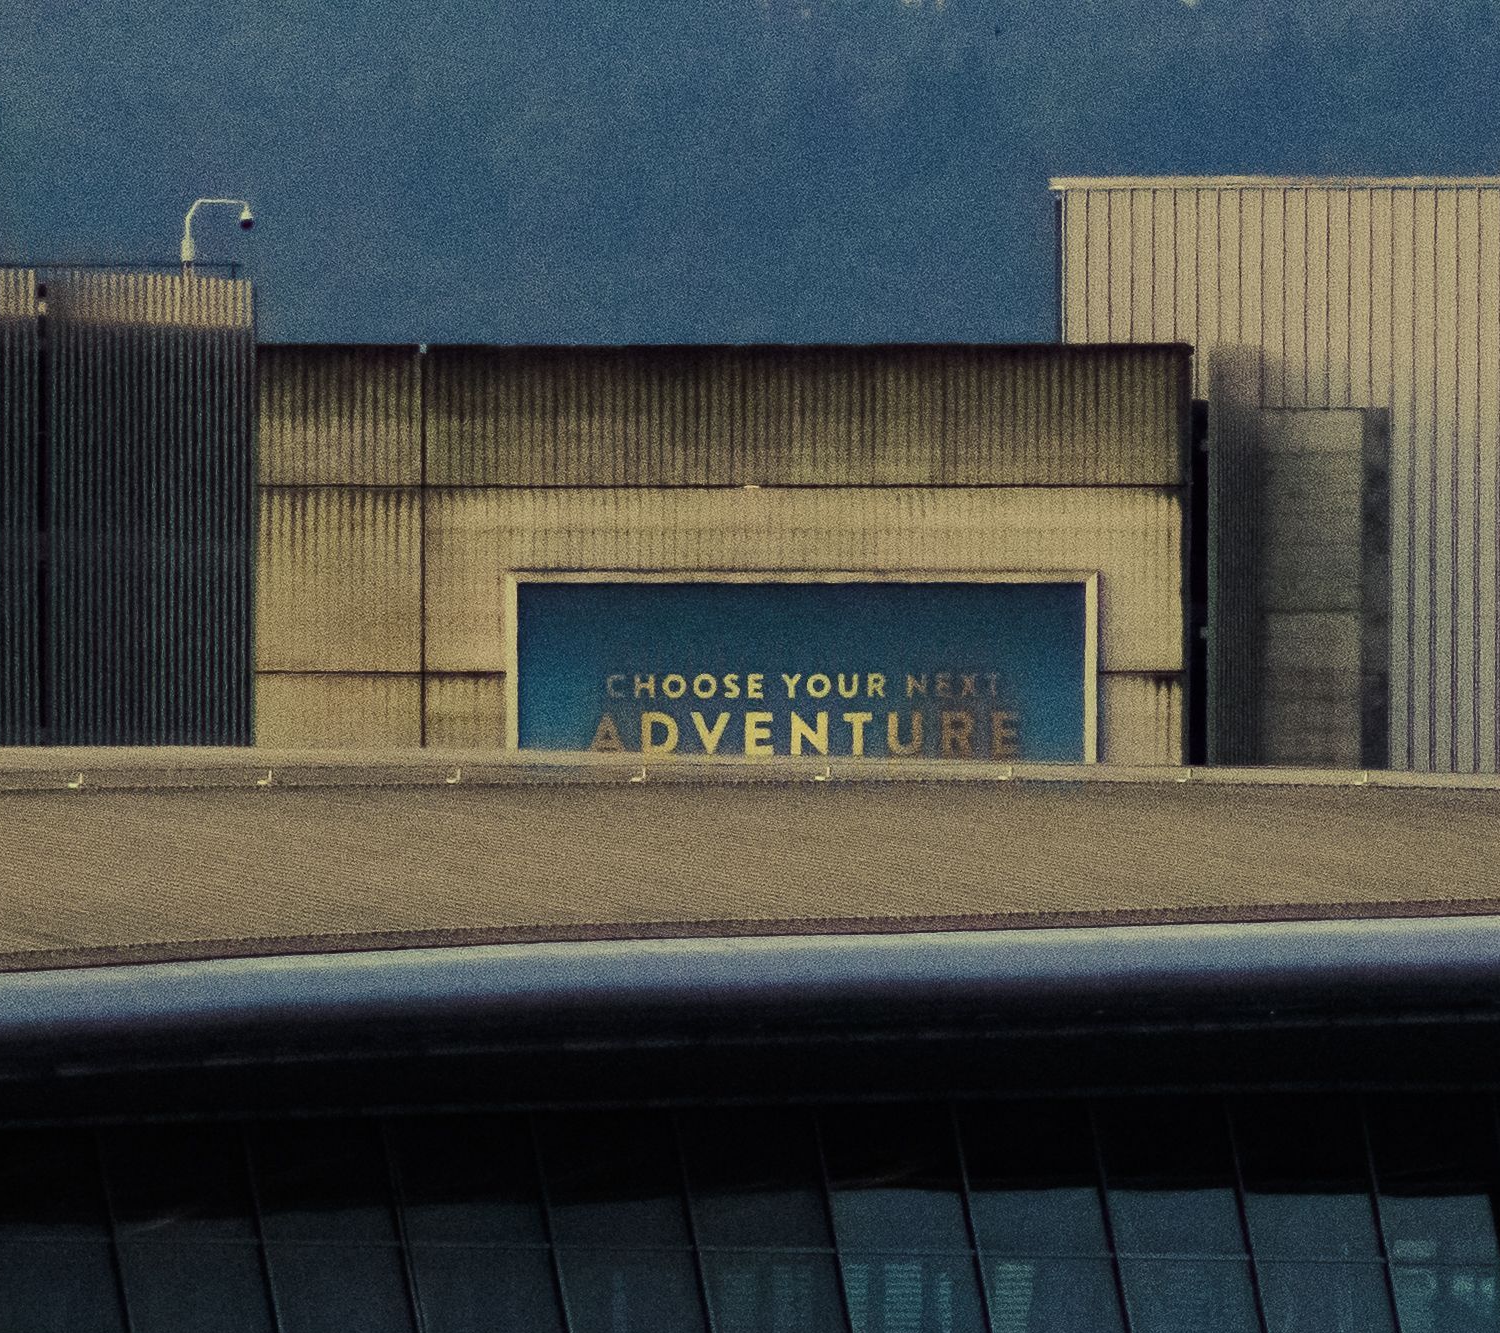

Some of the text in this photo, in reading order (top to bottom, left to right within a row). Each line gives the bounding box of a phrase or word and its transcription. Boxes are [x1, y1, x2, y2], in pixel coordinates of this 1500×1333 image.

[606, 672, 1000, 700] CHOOSE YOUR NEXT
[589, 711, 1021, 758] ADVENTURE
